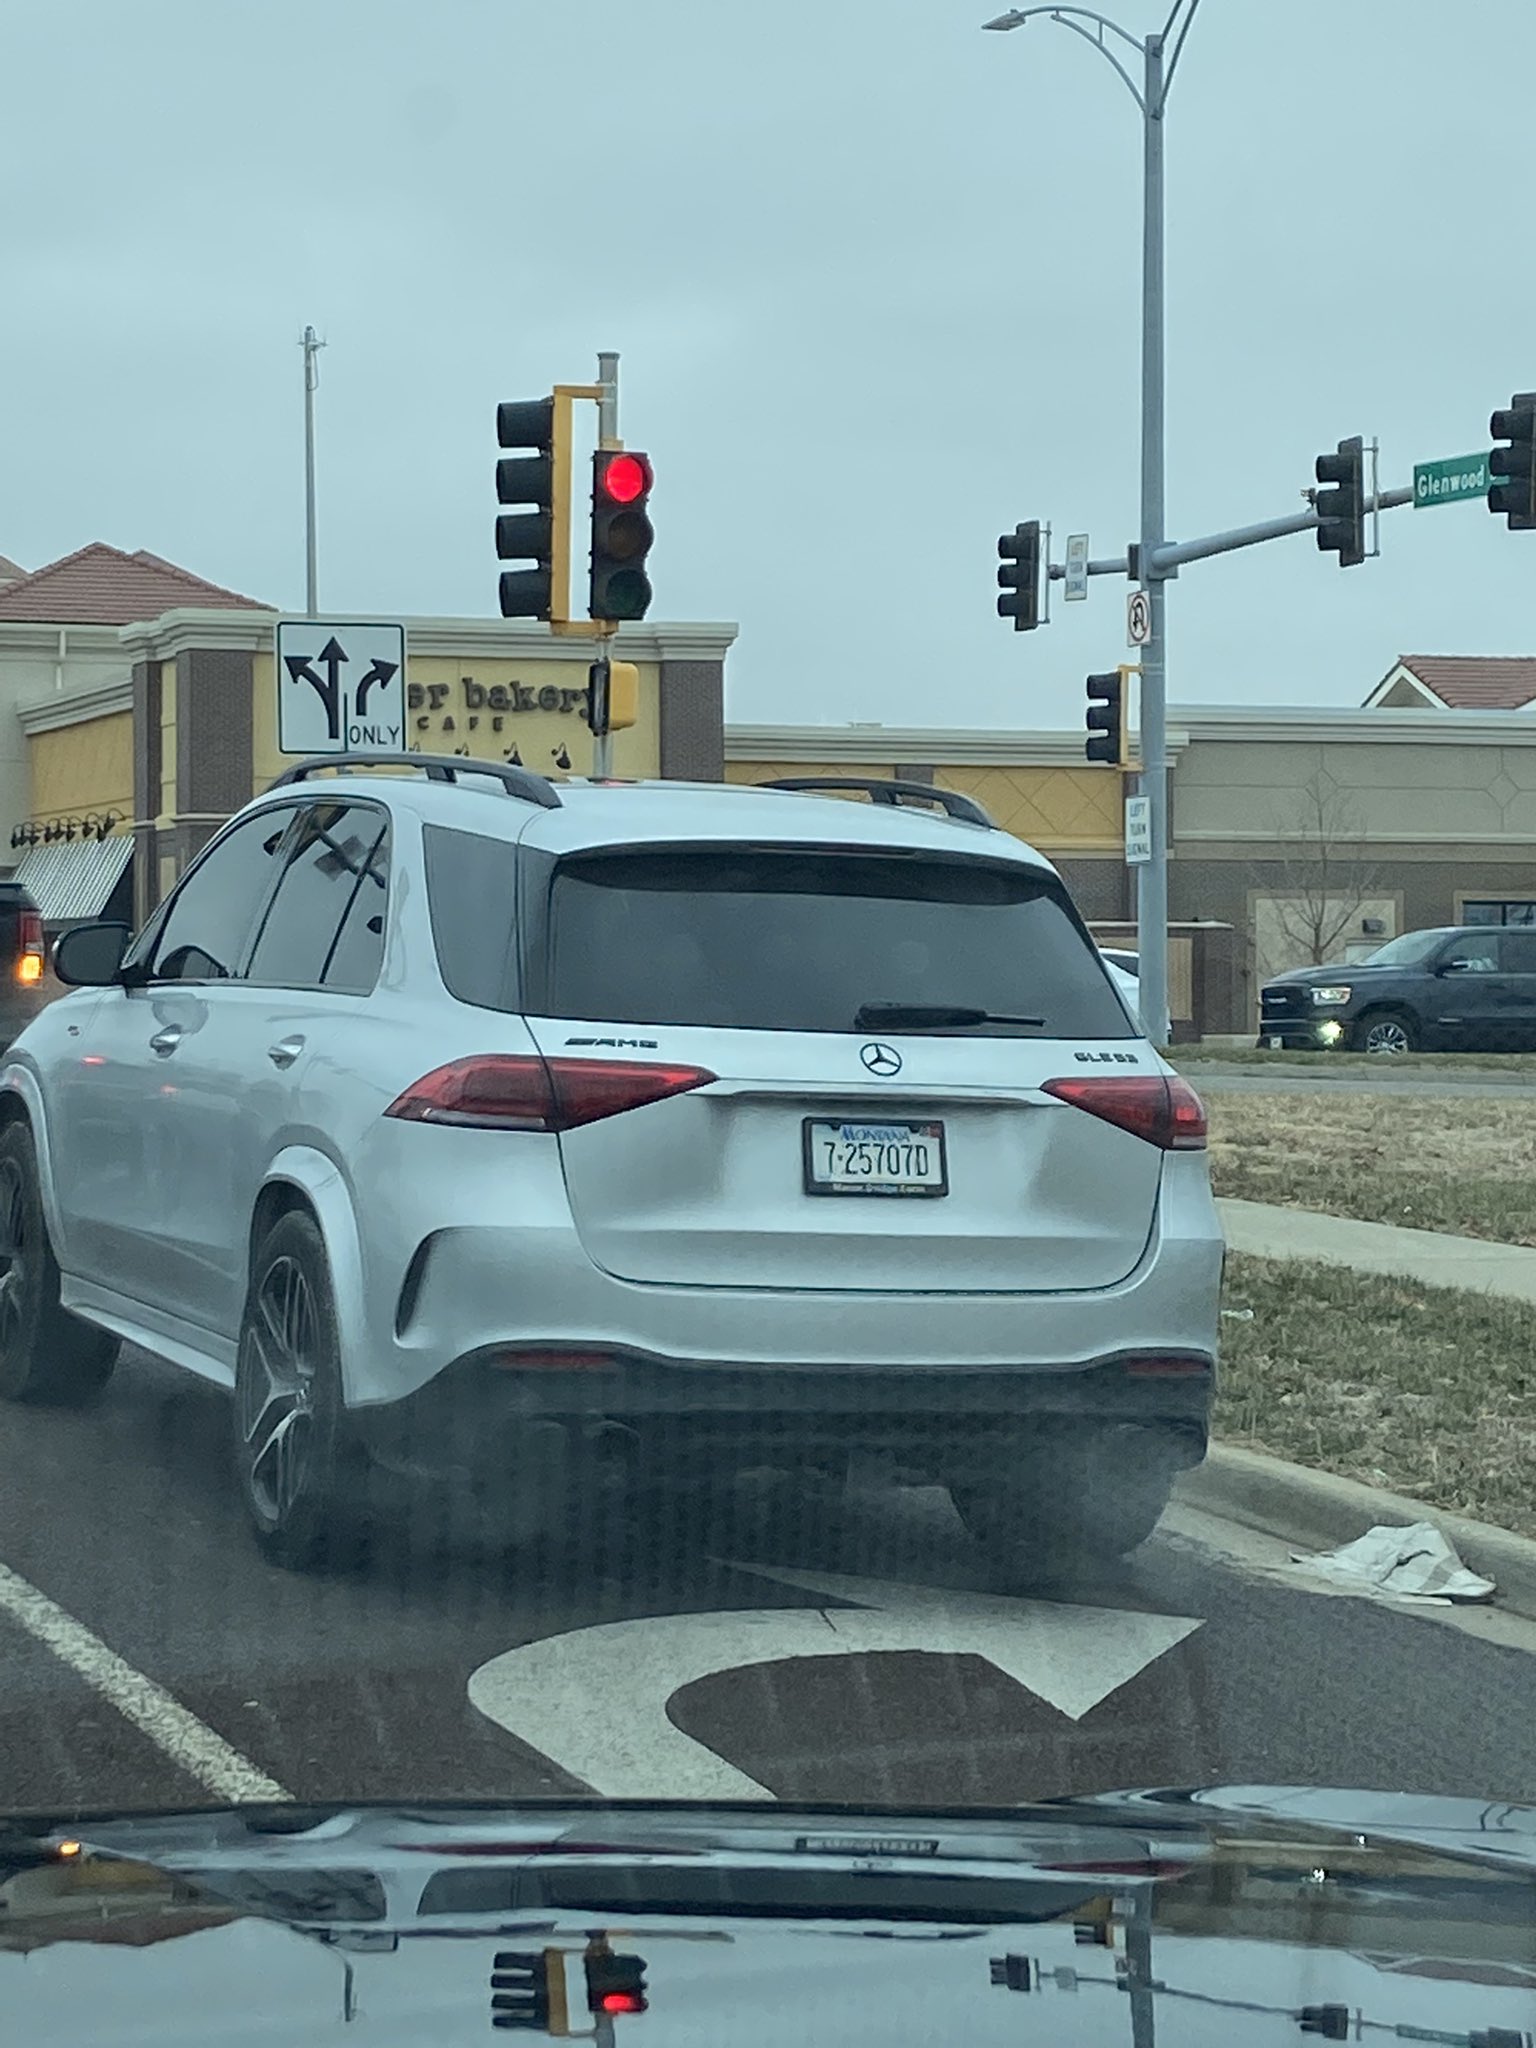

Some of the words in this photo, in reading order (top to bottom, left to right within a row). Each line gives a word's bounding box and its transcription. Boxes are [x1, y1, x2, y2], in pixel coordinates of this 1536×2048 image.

[1417, 463, 1486, 498] Glenwood
[416, 716, 505, 732] CAFE
[349, 725, 400, 745] ONLY
